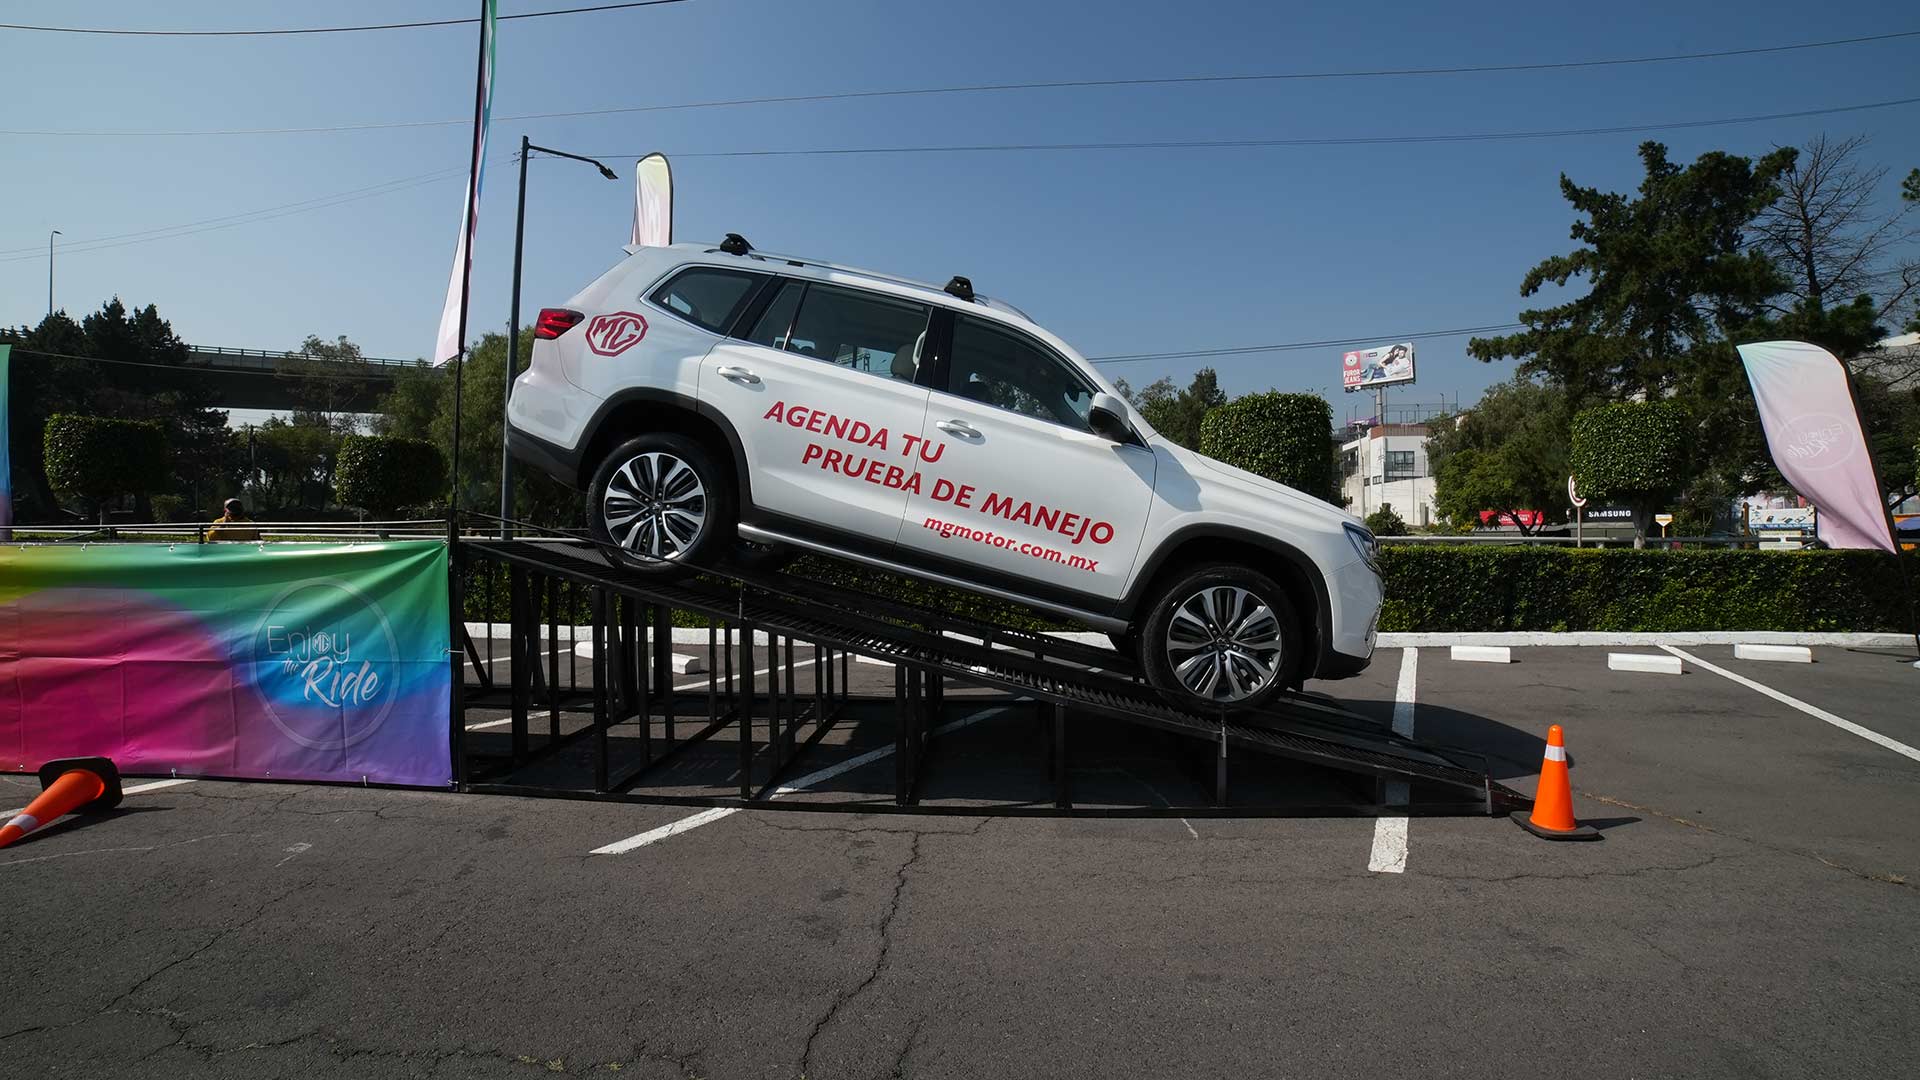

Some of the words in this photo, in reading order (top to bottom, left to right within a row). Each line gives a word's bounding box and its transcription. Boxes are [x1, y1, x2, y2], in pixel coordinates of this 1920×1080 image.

[764, 401, 889, 450] AGENDA
[902, 433, 946, 463] TU
[801, 443, 922, 495] PRUEBA
[930, 478, 976, 509] DE
[980, 492, 1115, 545] MANEJO
[1588, 510, 1632, 518] SAMSUNG
[922, 516, 1099, 572] mgmotor.com.mx
[301, 656, 385, 707] Ride
